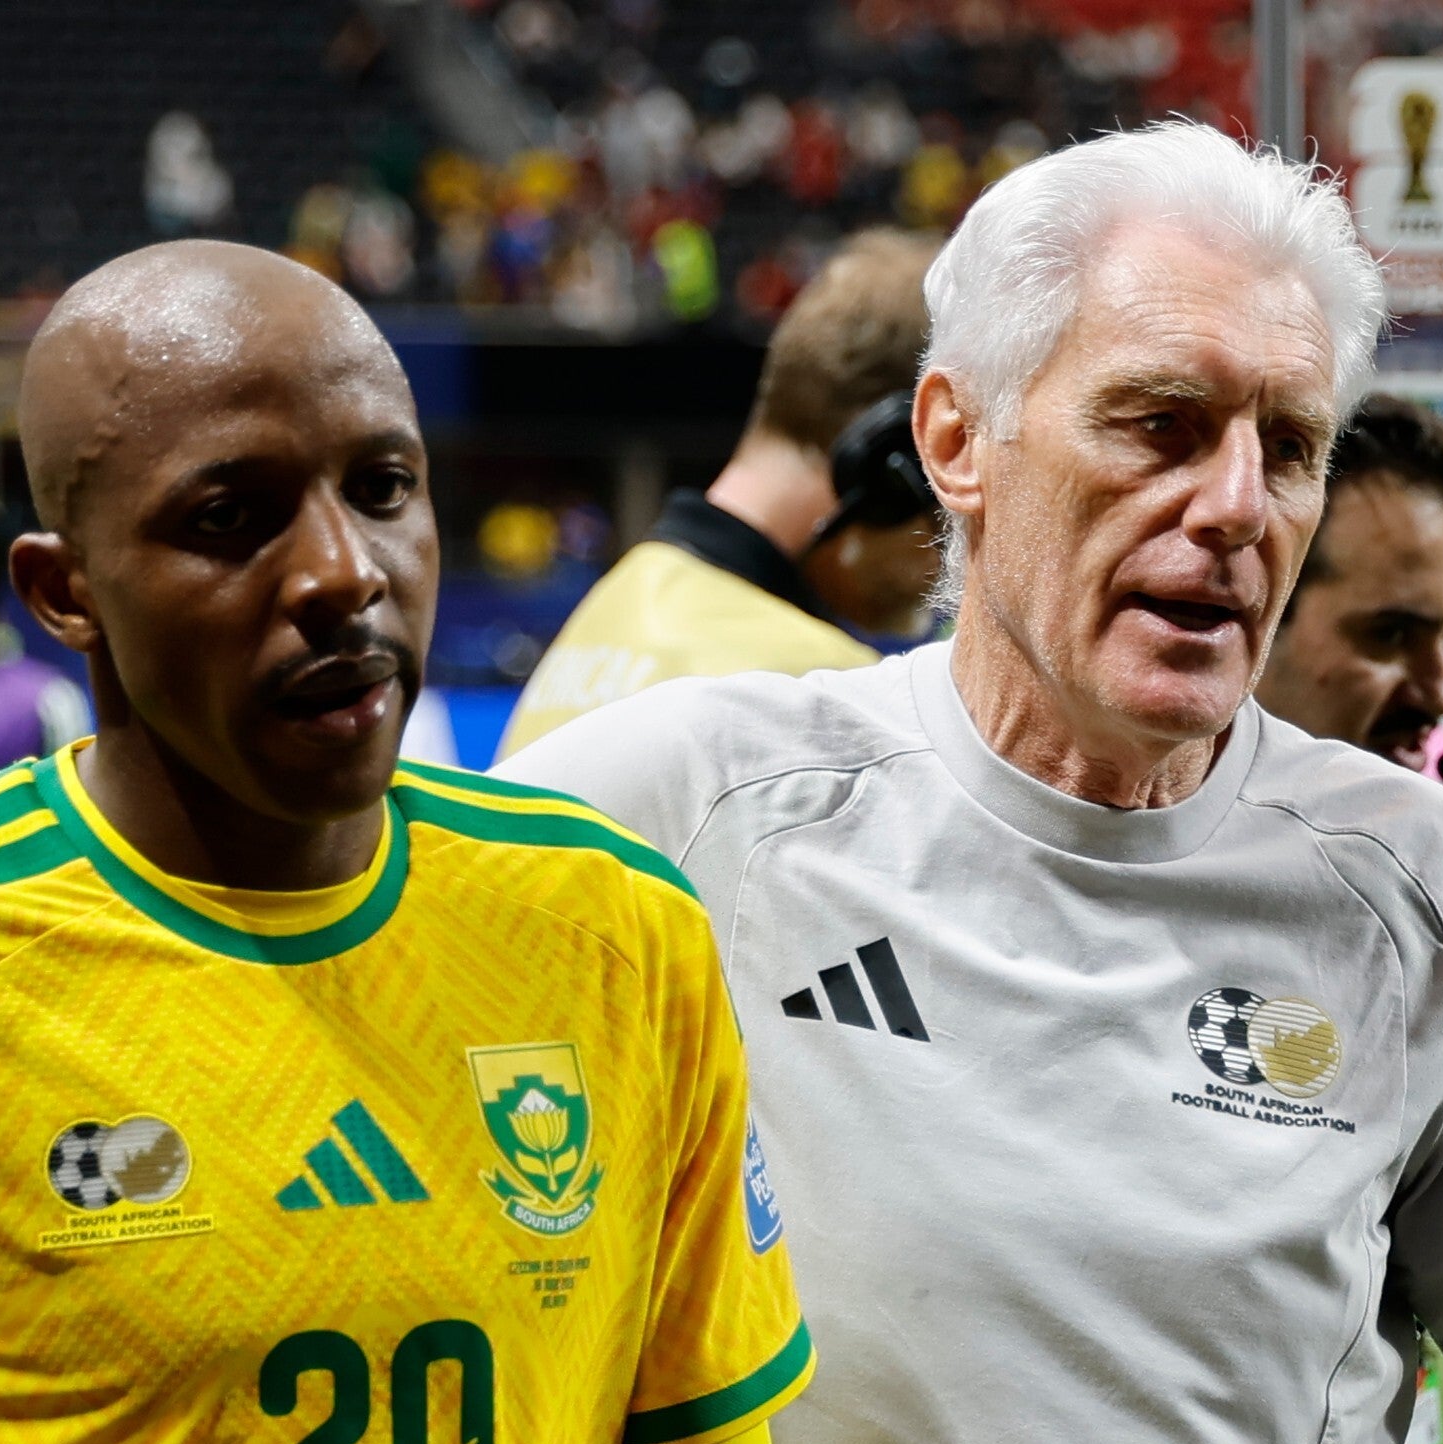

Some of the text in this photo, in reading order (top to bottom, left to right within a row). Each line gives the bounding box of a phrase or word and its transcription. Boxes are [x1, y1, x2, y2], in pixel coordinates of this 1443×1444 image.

[1172, 1091, 1356, 1134] FOOTBALL ASSOCIATION
[1205, 1083, 1324, 1116] SOUTH AFRICAN
[42, 1216, 212, 1245] FOOTBALL ASSOCIATION
[69, 1207, 181, 1229] SOUTH AFRICAN
[515, 1202, 592, 1232] SOUTH AFRICA
